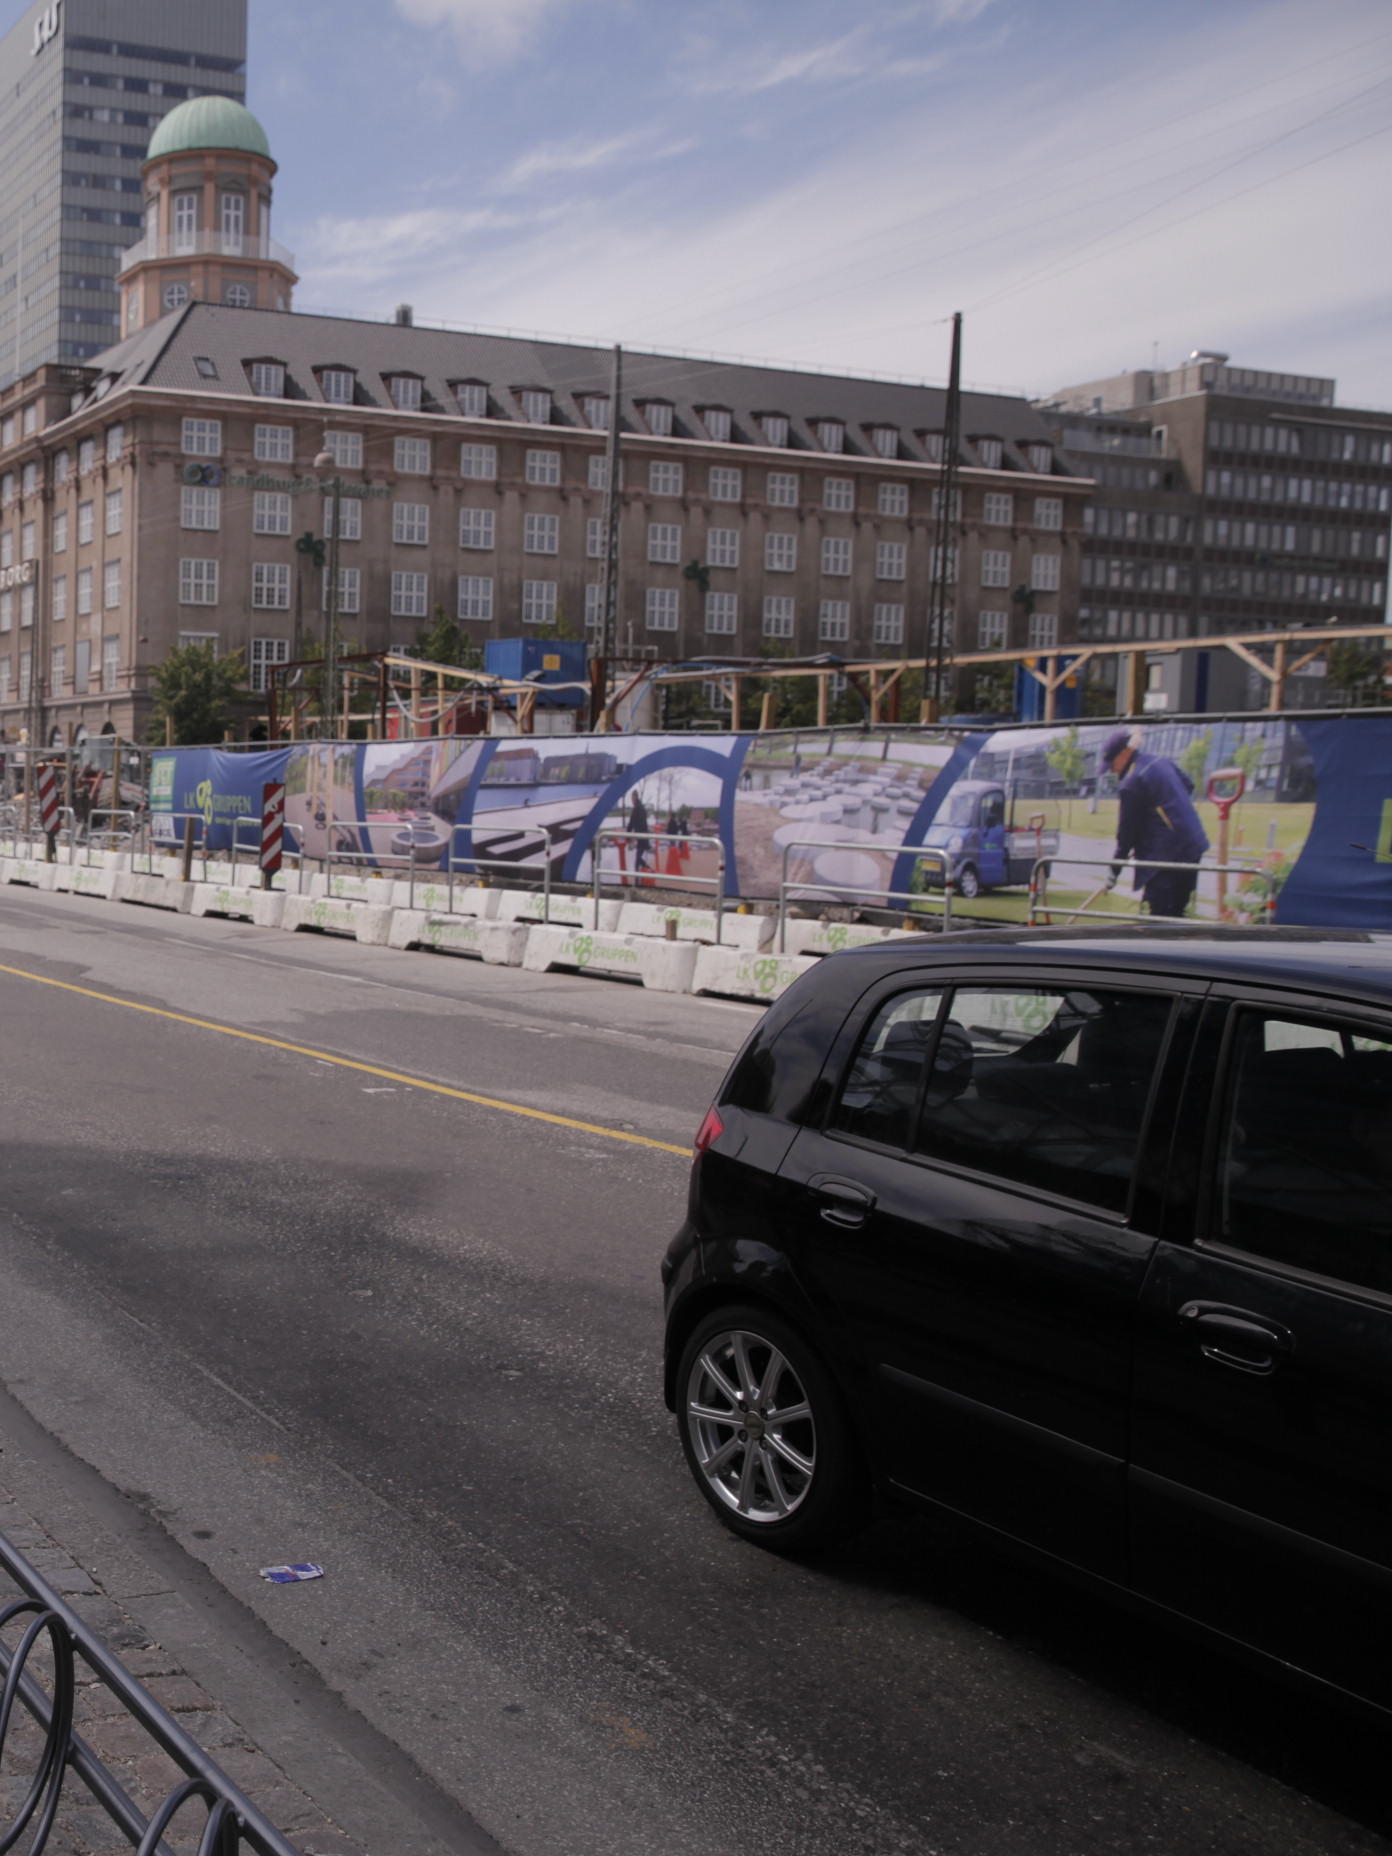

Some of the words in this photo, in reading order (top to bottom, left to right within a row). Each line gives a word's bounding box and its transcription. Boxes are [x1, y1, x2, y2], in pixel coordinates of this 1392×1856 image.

[183, 792, 196, 810] LK
[212, 793, 253, 814] GRUPPEN
[593, 946, 639, 963] GRUPPEN
[735, 966, 750, 979] LK
